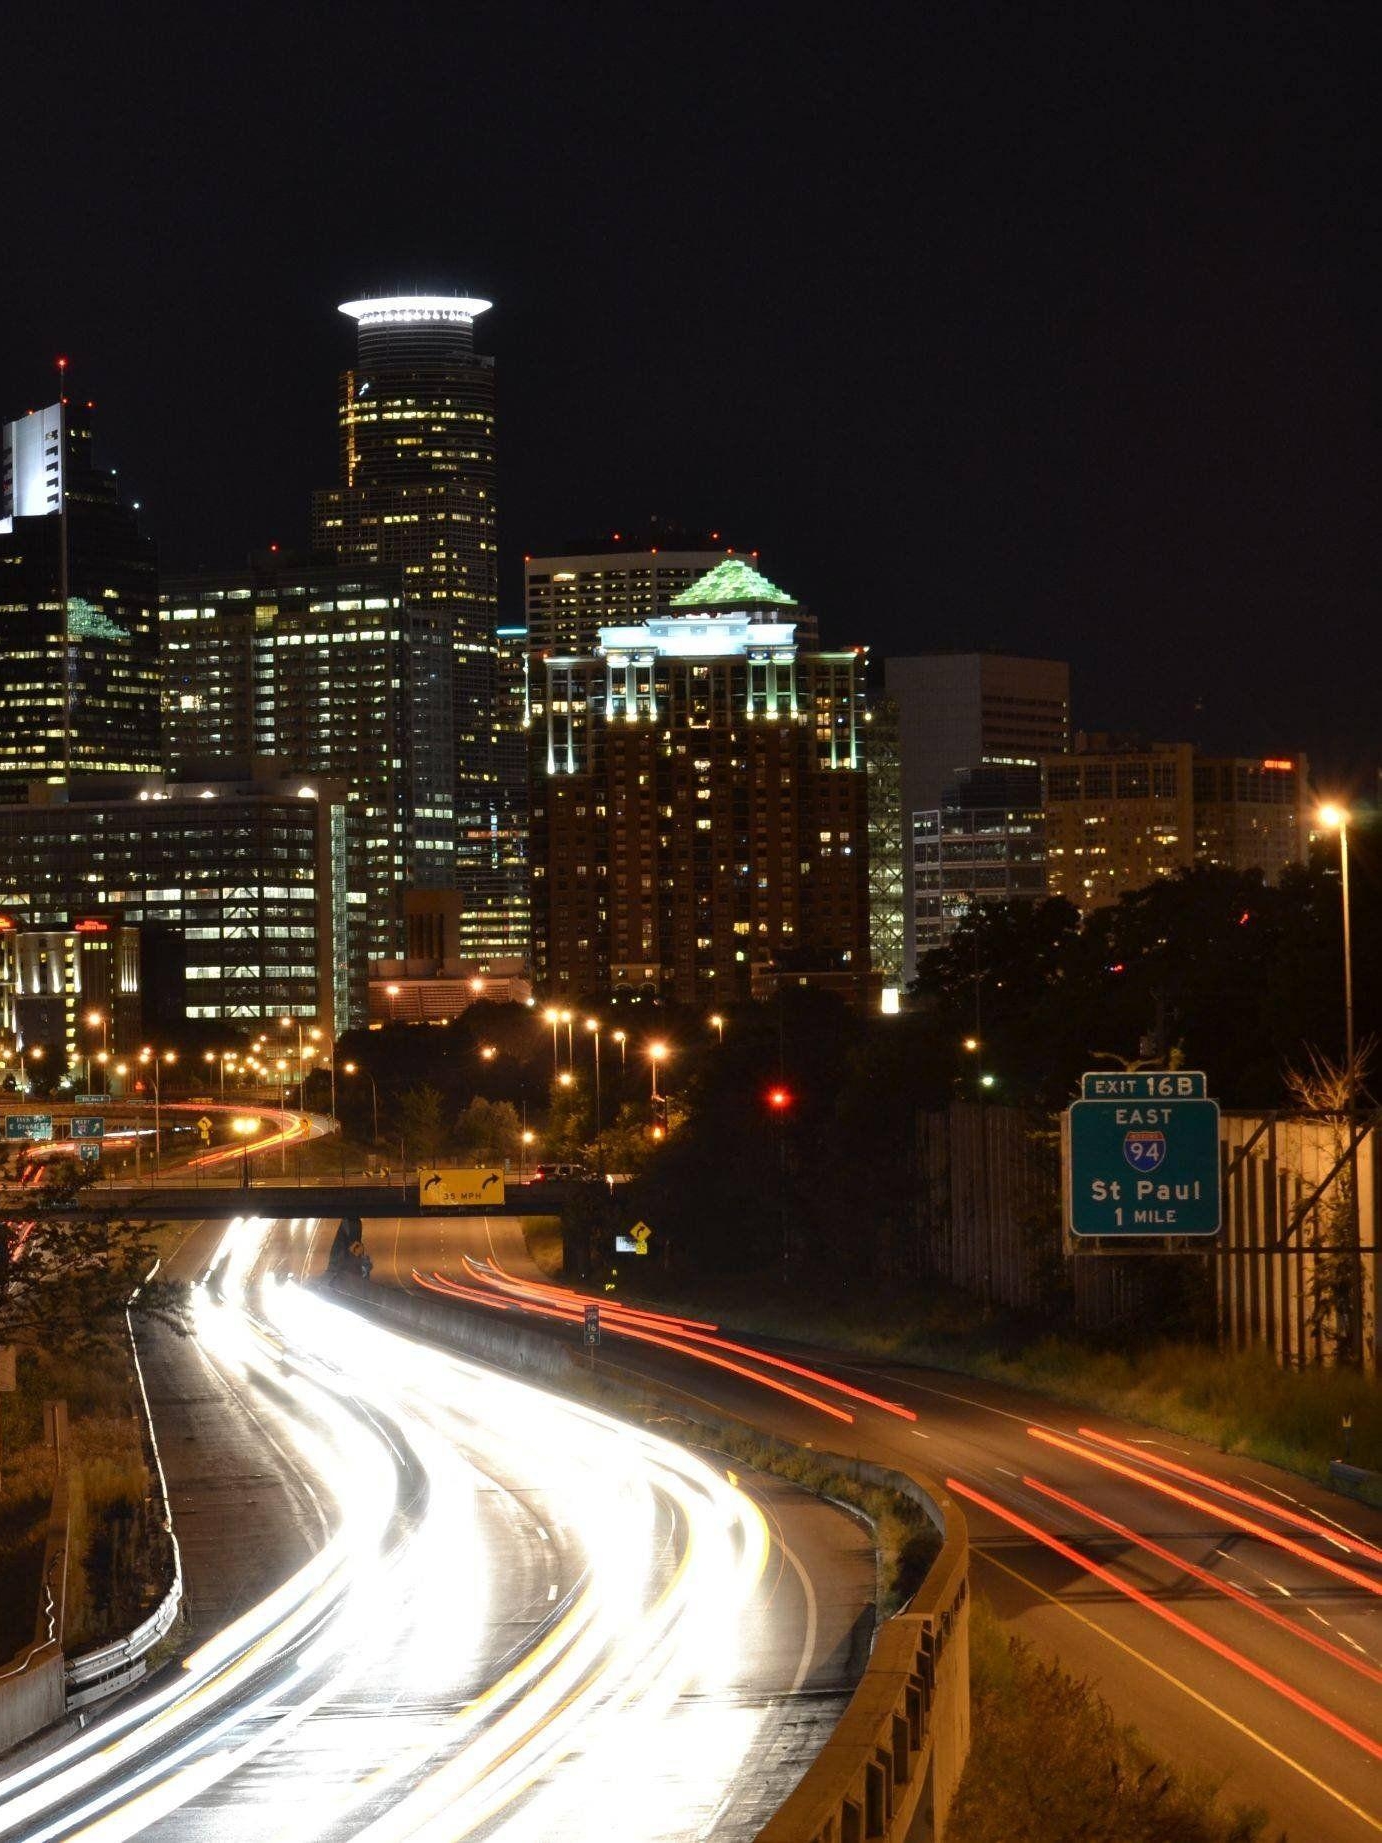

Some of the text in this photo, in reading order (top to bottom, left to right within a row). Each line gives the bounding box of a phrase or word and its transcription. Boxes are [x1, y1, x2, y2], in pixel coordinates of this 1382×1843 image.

[1095, 1077, 1194, 1097] EXIT 16B
[1116, 1109, 1173, 1124] EAST
[1130, 1142, 1160, 1162] 94
[443, 1192, 482, 1200] 35 MPH
[1091, 1180, 1201, 1200] St Paul
[1114, 1207, 1177, 1226] 1 MILE
[587, 1323, 597, 1332] 16
